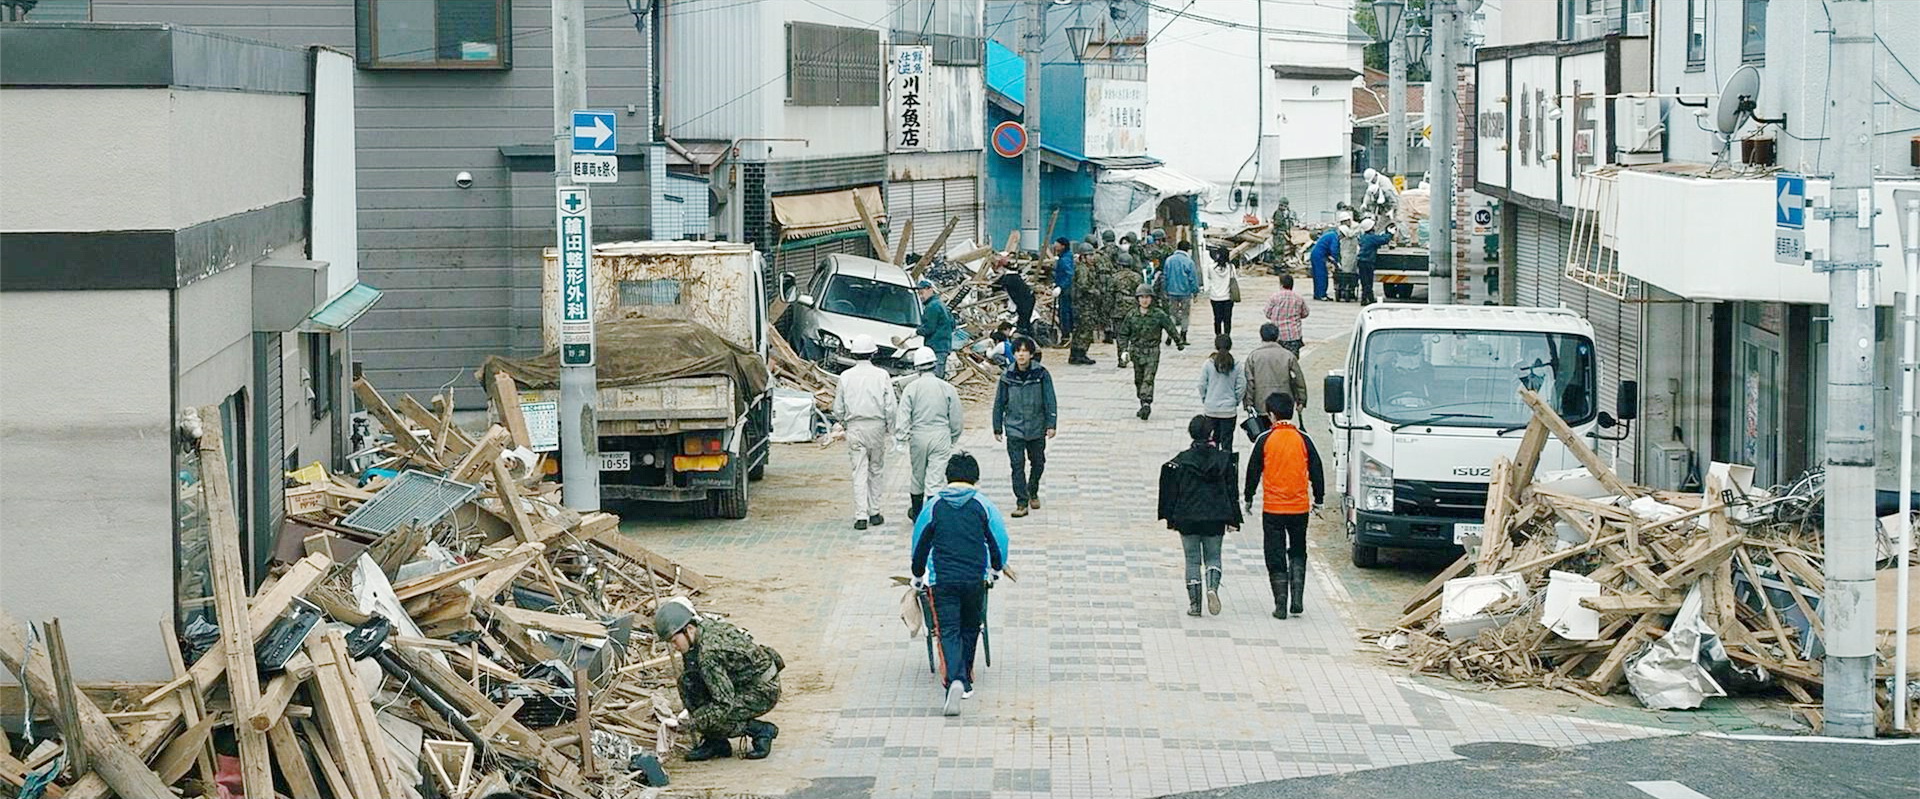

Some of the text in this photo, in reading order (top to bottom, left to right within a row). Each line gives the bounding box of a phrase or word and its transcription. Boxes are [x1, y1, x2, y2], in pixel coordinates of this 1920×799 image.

[900, 75, 921, 147] 川本魚店
[601, 459, 629, 469] 10-55
[1453, 467, 1491, 477] ISUZ
